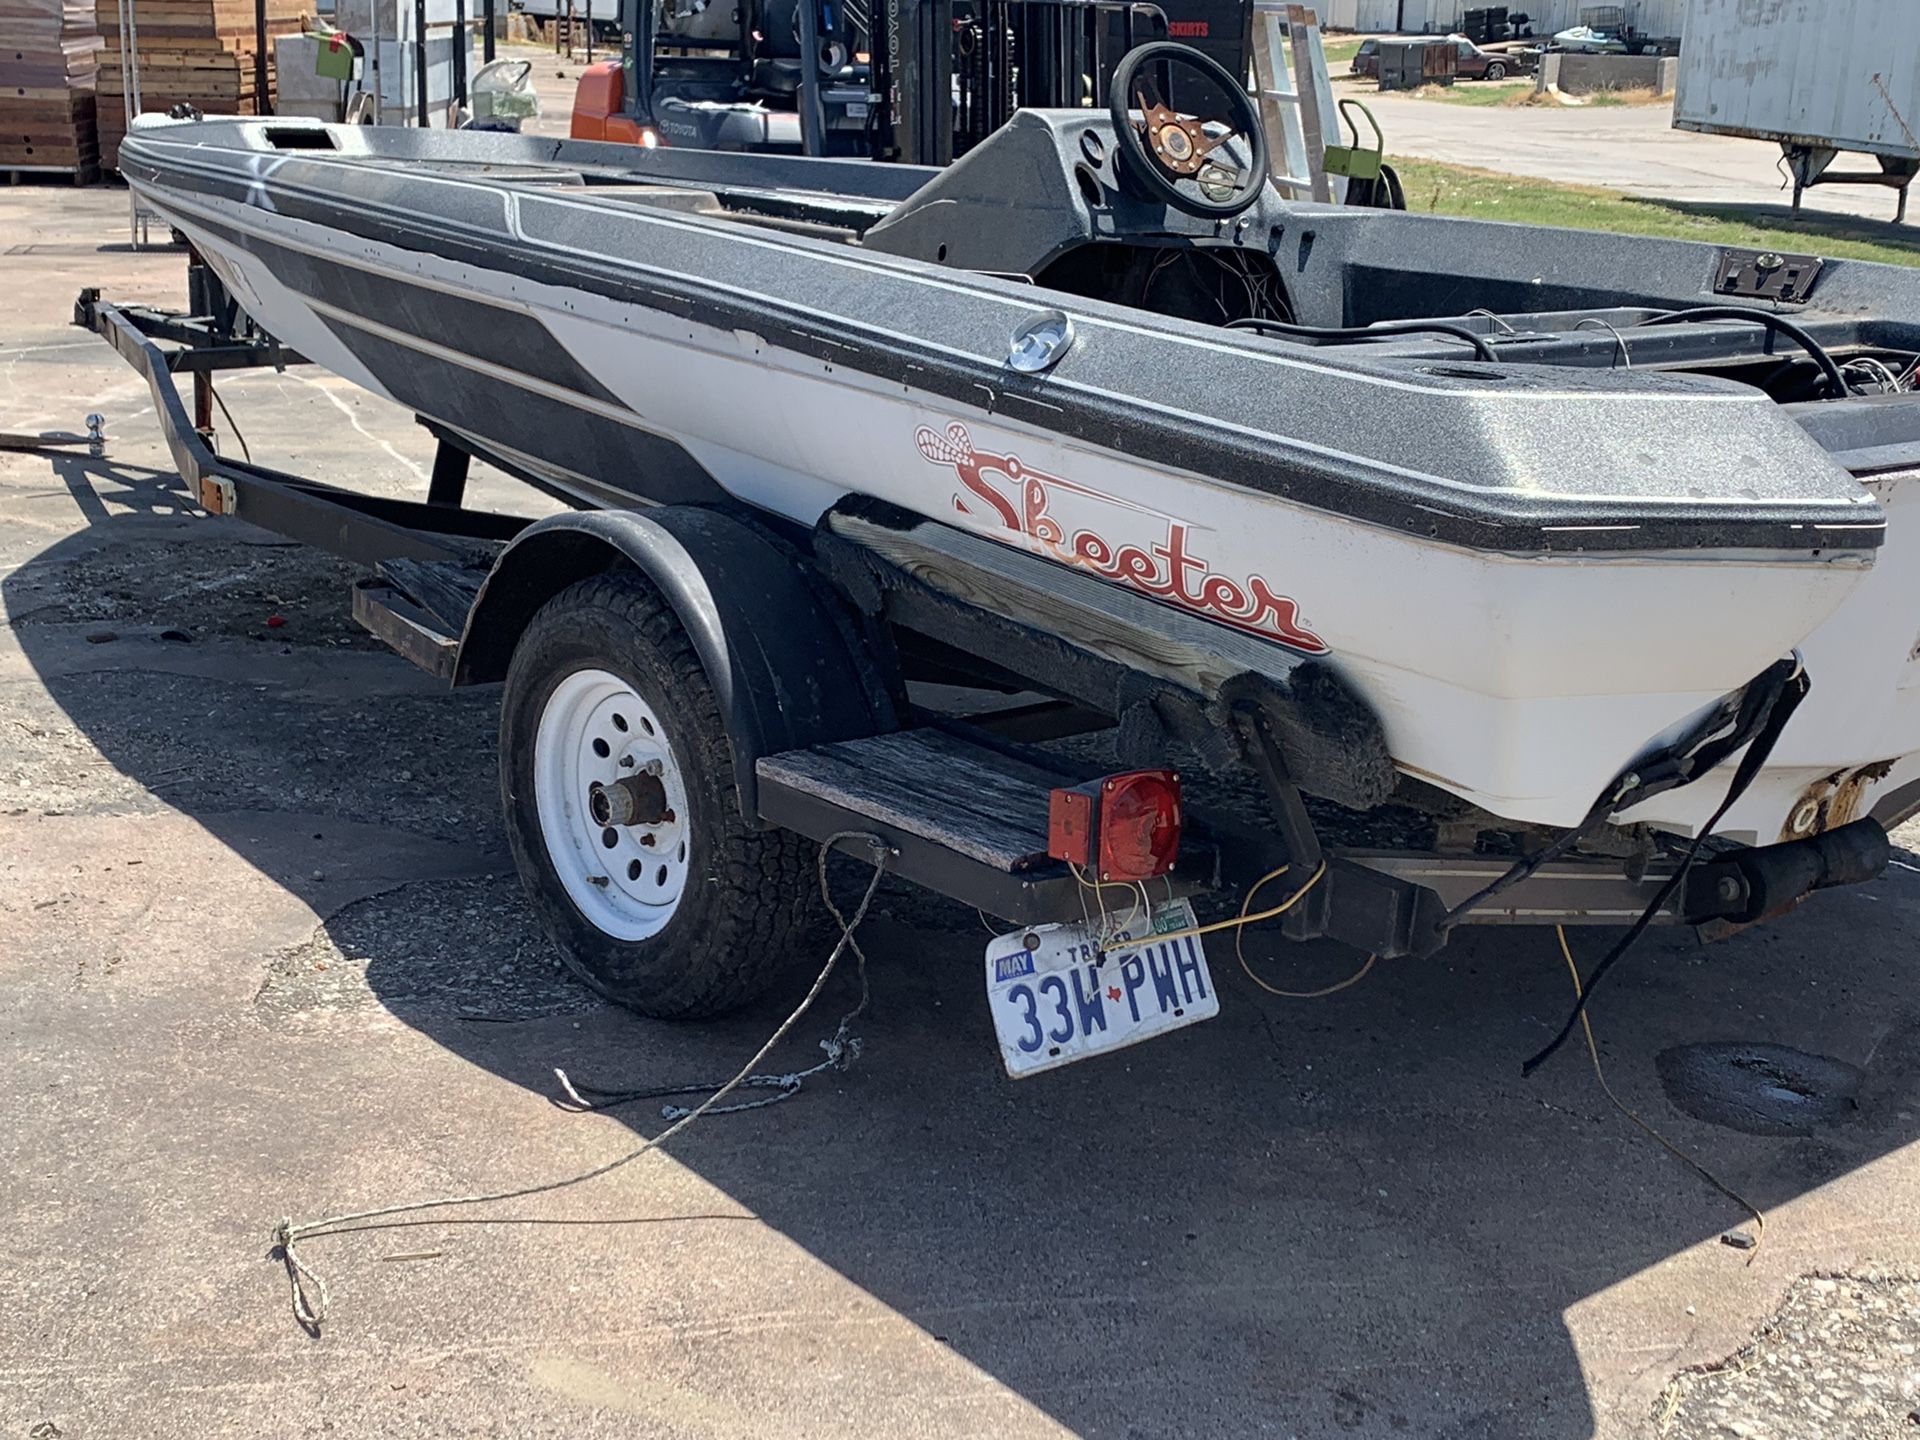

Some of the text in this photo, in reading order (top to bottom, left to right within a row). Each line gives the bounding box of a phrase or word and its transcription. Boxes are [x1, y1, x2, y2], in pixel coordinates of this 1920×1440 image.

[1167, 22, 1209, 37] SKIRTS
[670, 121, 697, 138] TOYOTA
[998, 953, 1029, 977] MAY
[1008, 935, 1207, 1053] 33W PWH
